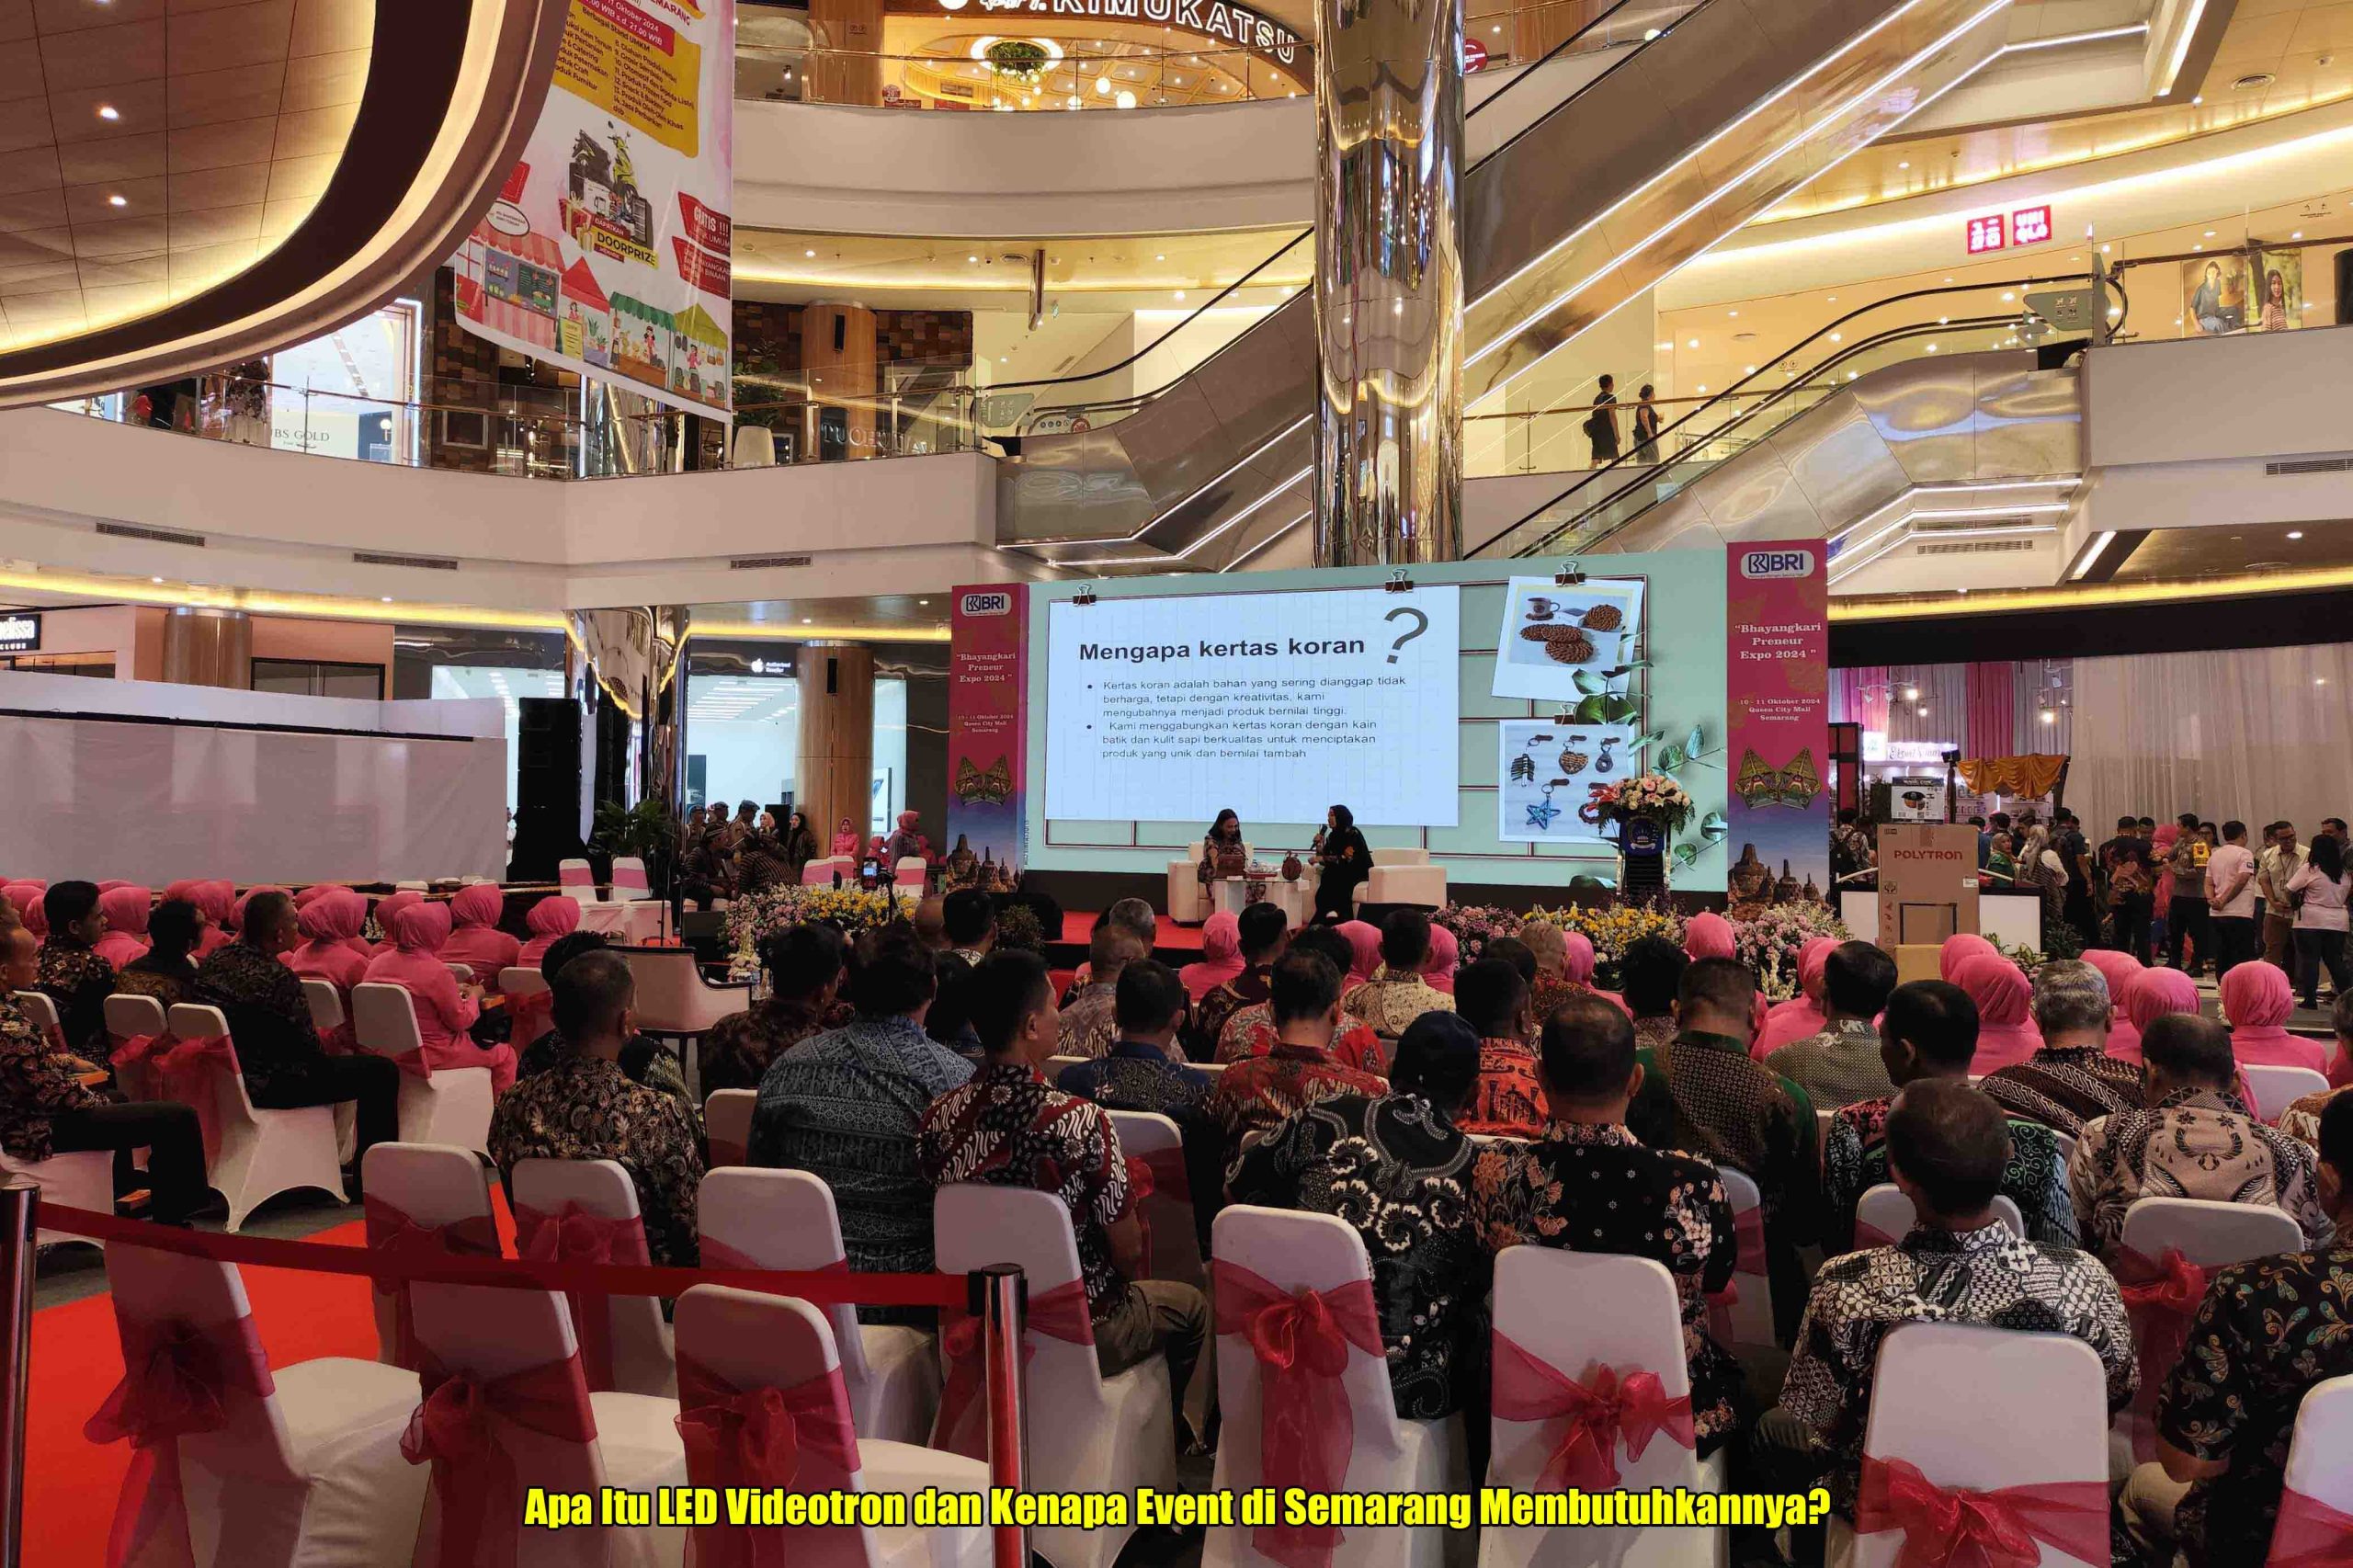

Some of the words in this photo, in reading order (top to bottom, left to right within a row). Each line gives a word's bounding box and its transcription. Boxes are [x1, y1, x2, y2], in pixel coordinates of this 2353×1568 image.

[616, 2, 642, 22] Oktober
[643, 18, 659, 32] 2024
[601, 3, 616, 17] WIB
[629, 22, 647, 37] 21.00
[648, 33, 663, 46] WIB
[1053, 0, 1294, 63] KIMUKATSU
[610, 26, 629, 40] Stand
[629, 35, 651, 52] UMKM
[573, 43, 599, 63] Catering
[694, 206, 717, 233] GRATIS
[709, 233, 731, 247] UMUM
[597, 231, 656, 267] DOORPRIZE
[272, 428, 290, 439] BS
[294, 430, 330, 442] GOLD
[1769, 553, 1804, 572] BRI
[981, 596, 1005, 610] BRI
[1734, 621, 1822, 635] “Bhayangkari
[1080, 643, 1190, 664] Mengapa
[1199, 640, 1279, 657] kertas
[1289, 638, 1365, 655] koran
[1383, 607, 1428, 665] ?
[1752, 637, 1804, 646] Preneur
[1740, 651, 1772, 661] Expo
[1775, 649, 1807, 659] 2024
[968, 664, 1005, 672] Preneur
[960, 675, 982, 684] Expo
[1103, 681, 1138, 690] Kertas
[1141, 681, 1170, 689] koran
[1174, 680, 1210, 689] adalah
[1213, 679, 1247, 688] bahan
[1251, 679, 1278, 689] yang
[1281, 677, 1315, 688] sering
[1320, 677, 1373, 688] dianggap
[1378, 676, 1406, 686] tidak
[1103, 695, 1153, 704] berharga,
[1156, 694, 1186, 704] tetapi
[1189, 694, 1230, 704] dengan
[1233, 692, 1292, 702] kreativitas,
[1297, 692, 1324, 701] kami
[1103, 709, 1176, 719] mengubahnya
[1181, 708, 1224, 718] menjadi
[1227, 708, 1266, 717] produk
[1268, 707, 1309, 715] bernilai
[1313, 707, 1347, 716] tinggi.
[1109, 722, 1136, 730] Kami
[1139, 722, 1229, 732] menggabungkan
[1233, 721, 1267, 730] kertas
[1270, 721, 1302, 729] koran
[1305, 721, 1348, 731] dengan
[1352, 720, 1377, 729] kain
[1102, 735, 1127, 744] batik
[1131, 735, 1150, 744] dan
[1154, 735, 1175, 744] kulit
[1177, 736, 1200, 745] sapi
[1203, 735, 1263, 744] berkualitas
[1267, 735, 1297, 744] untuk
[1302, 735, 1376, 744] menciptakan
[1102, 750, 1138, 759] produk
[1142, 751, 1167, 759] yang
[1170, 749, 1192, 758] unik
[1196, 749, 1216, 758] dan
[1220, 749, 1259, 758] bernilai
[1264, 749, 1306, 758] tambah
